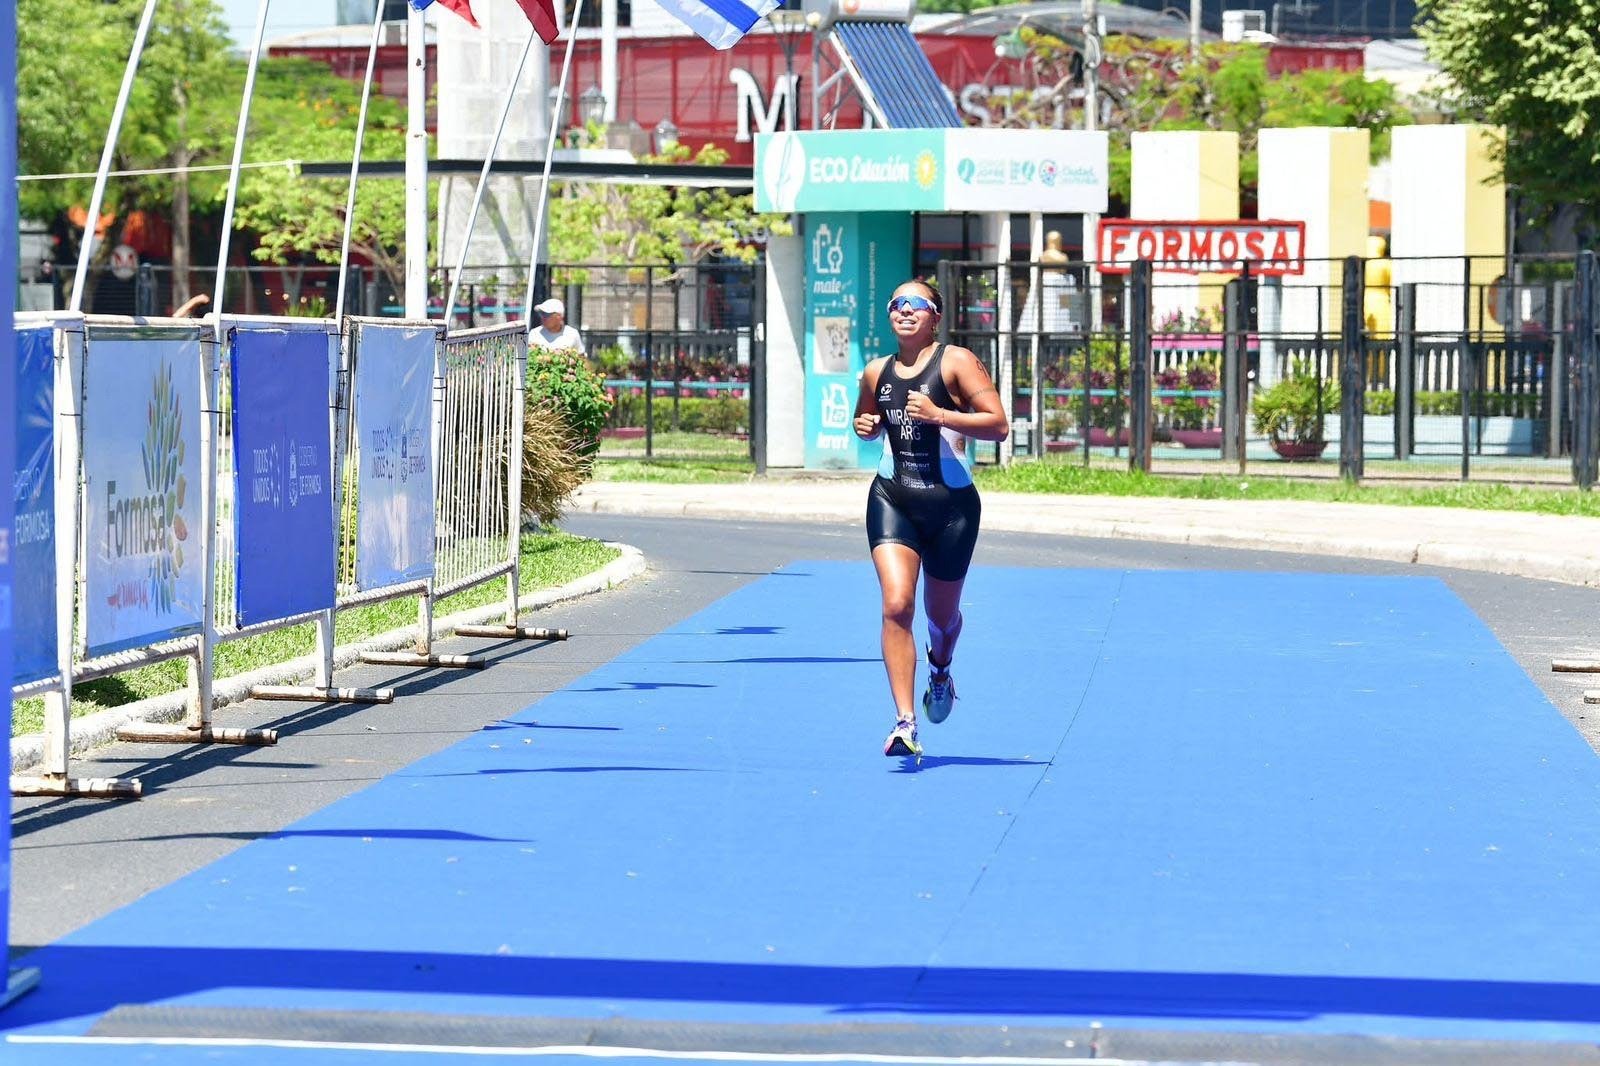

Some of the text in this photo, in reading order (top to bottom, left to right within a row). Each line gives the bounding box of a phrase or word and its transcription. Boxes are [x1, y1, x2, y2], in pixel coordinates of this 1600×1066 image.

[810, 155, 910, 183] ECO Estación
[1110, 229, 1291, 267] FORMOSA
[813, 277, 842, 294] mate
[900, 425, 921, 440] ARG
[253, 448, 269, 474] TODOS
[252, 477, 271, 503] UNIDOS
[106, 480, 166, 559] Formosa
